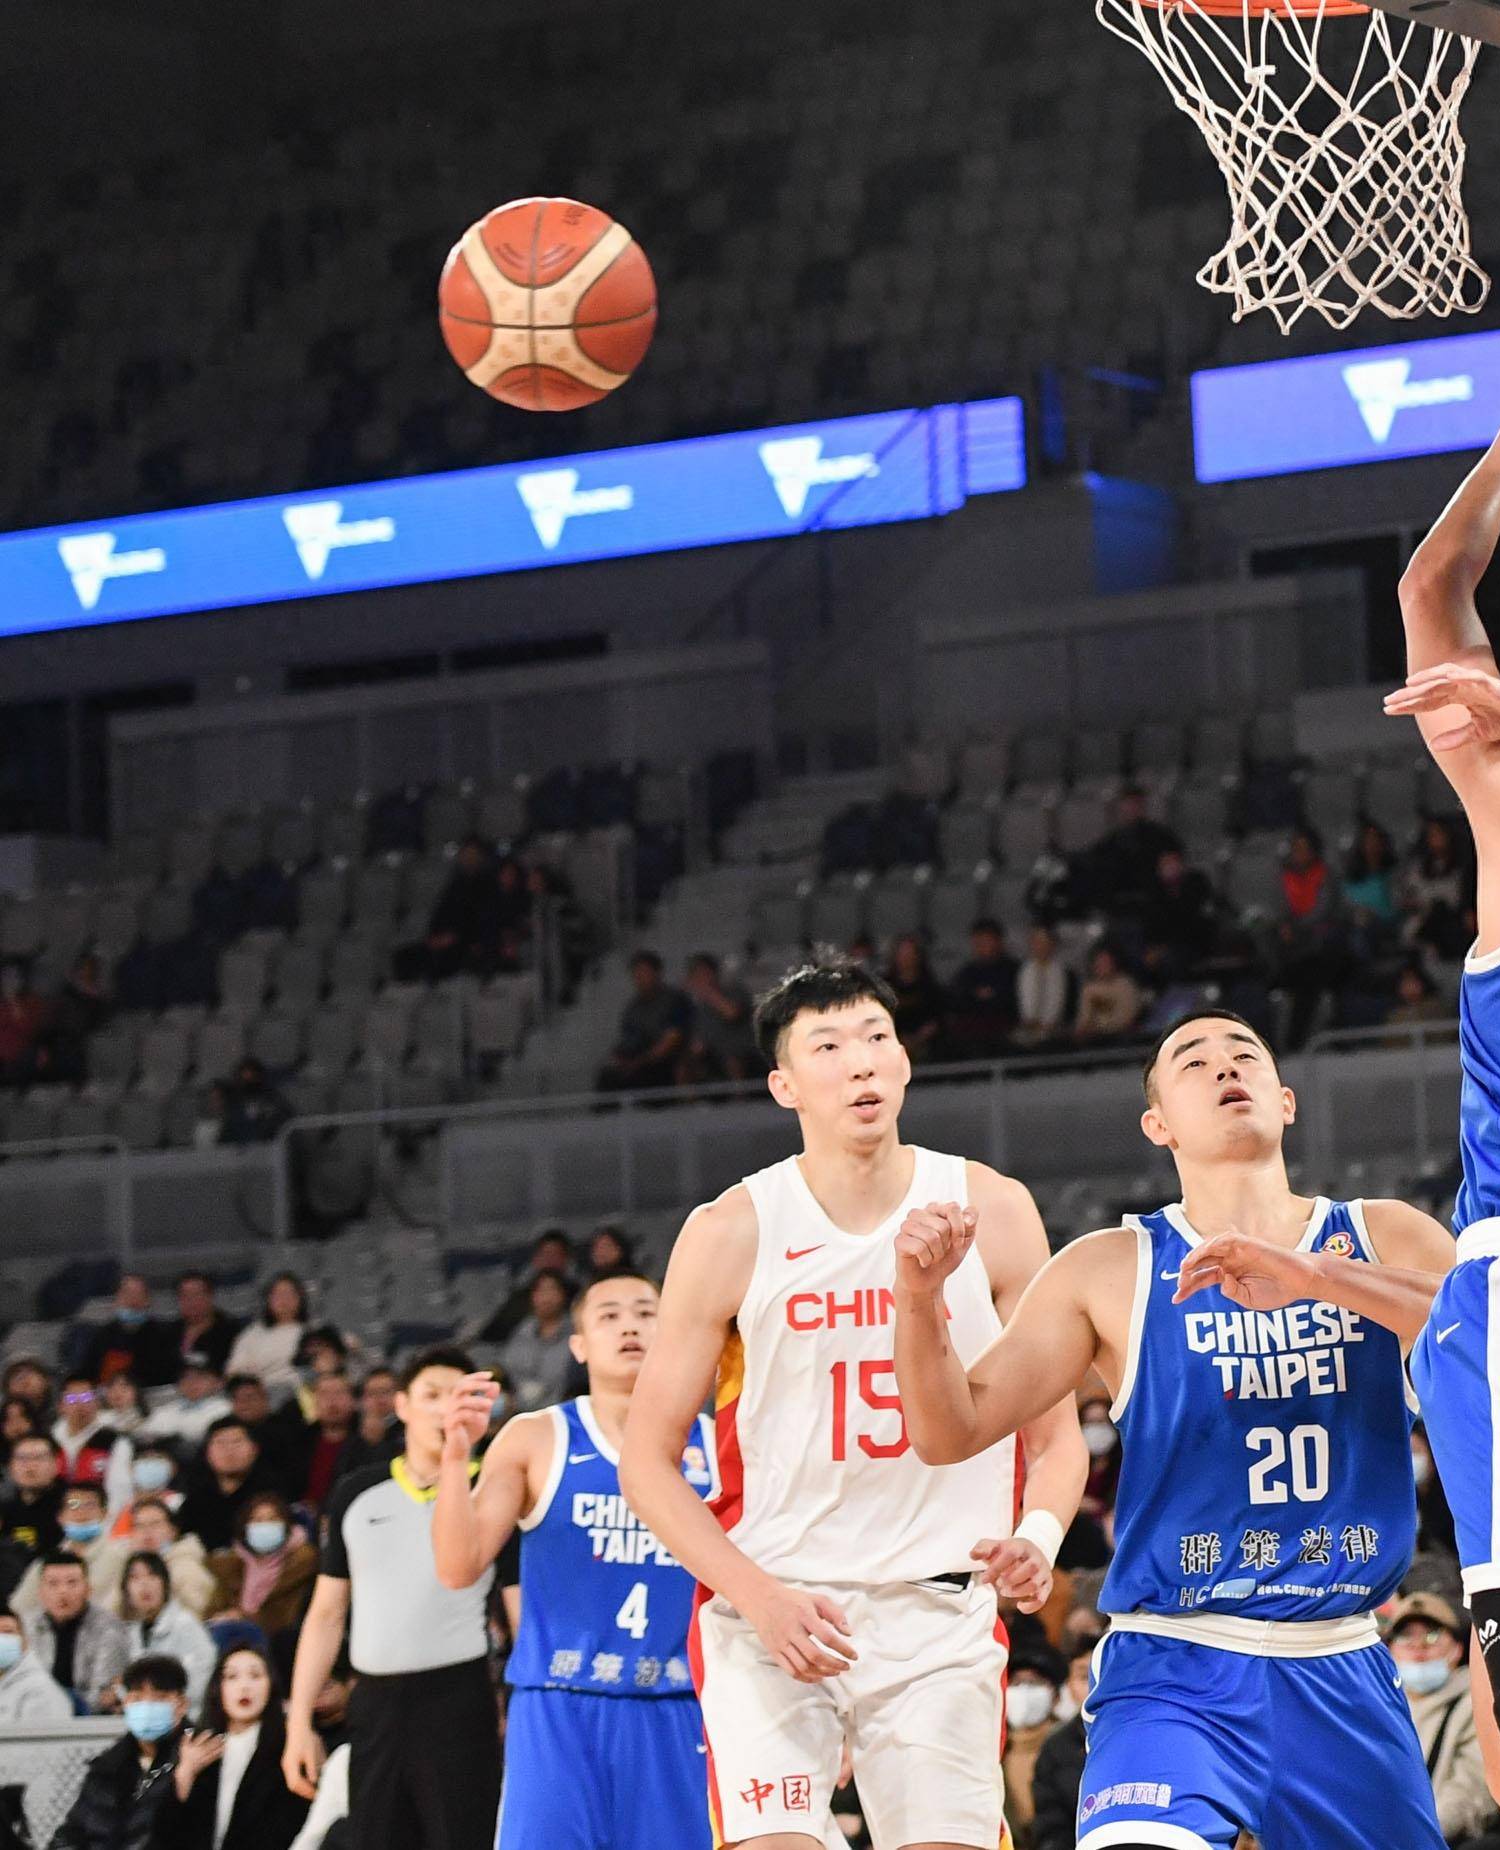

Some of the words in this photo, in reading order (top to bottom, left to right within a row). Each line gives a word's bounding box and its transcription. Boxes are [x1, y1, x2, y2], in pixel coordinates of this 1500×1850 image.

[1184, 1301, 1365, 1354] CHINESE
[1212, 1347, 1347, 1400] TAIPEI
[830, 1360, 911, 1461] 15
[1245, 1424, 1329, 1505] 20
[587, 1529, 682, 1567] TAIPE
[616, 1583, 649, 1639] 4
[739, 1774, 811, 1814] 中国
